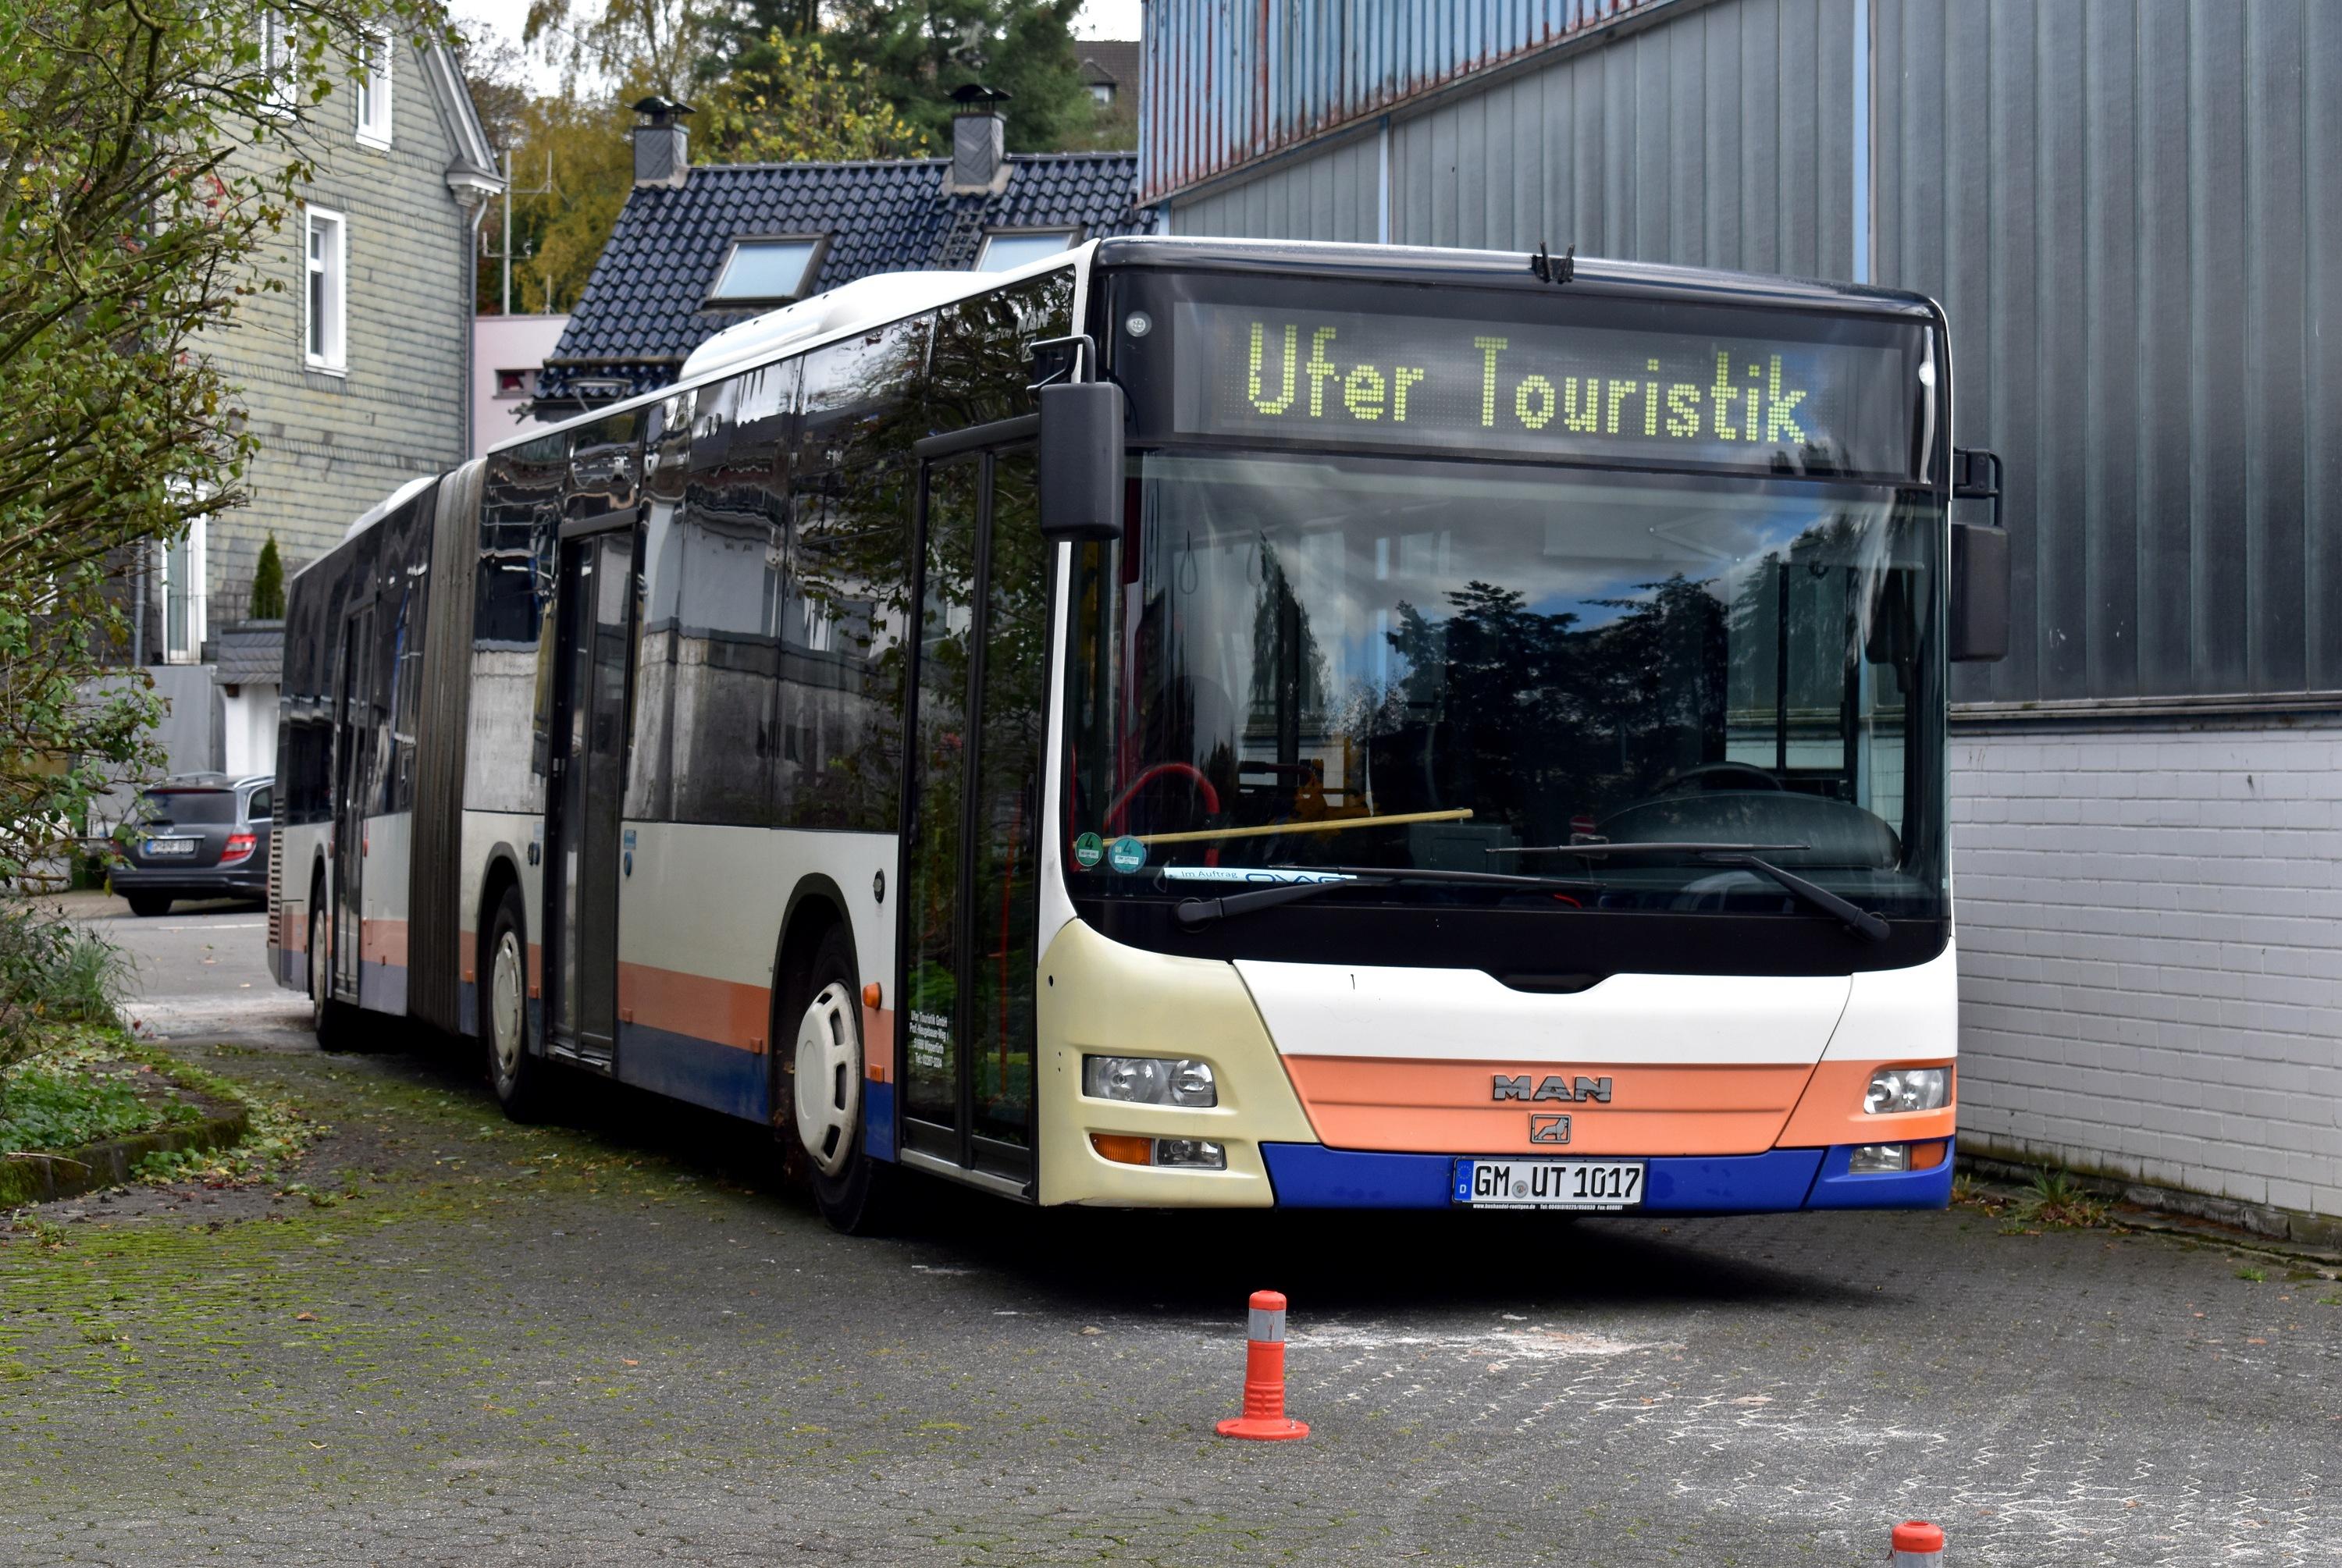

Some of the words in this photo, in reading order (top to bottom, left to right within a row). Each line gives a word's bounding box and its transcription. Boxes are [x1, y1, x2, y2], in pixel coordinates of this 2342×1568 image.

[1016, 307, 1050, 336] MAN
[1248, 321, 1425, 422] Ufer
[1474, 335, 1807, 444] Touristik
[1084, 834, 1094, 849] 4
[1123, 840, 1132, 855] 4
[1198, 870, 1238, 879] Auftrag
[1492, 1075, 1613, 1104] MAN
[1459, 1184, 1467, 1194] D
[1475, 1165, 1510, 1196] GM
[1531, 1166, 1567, 1197] UT
[1573, 1167, 1640, 1198] 1017
